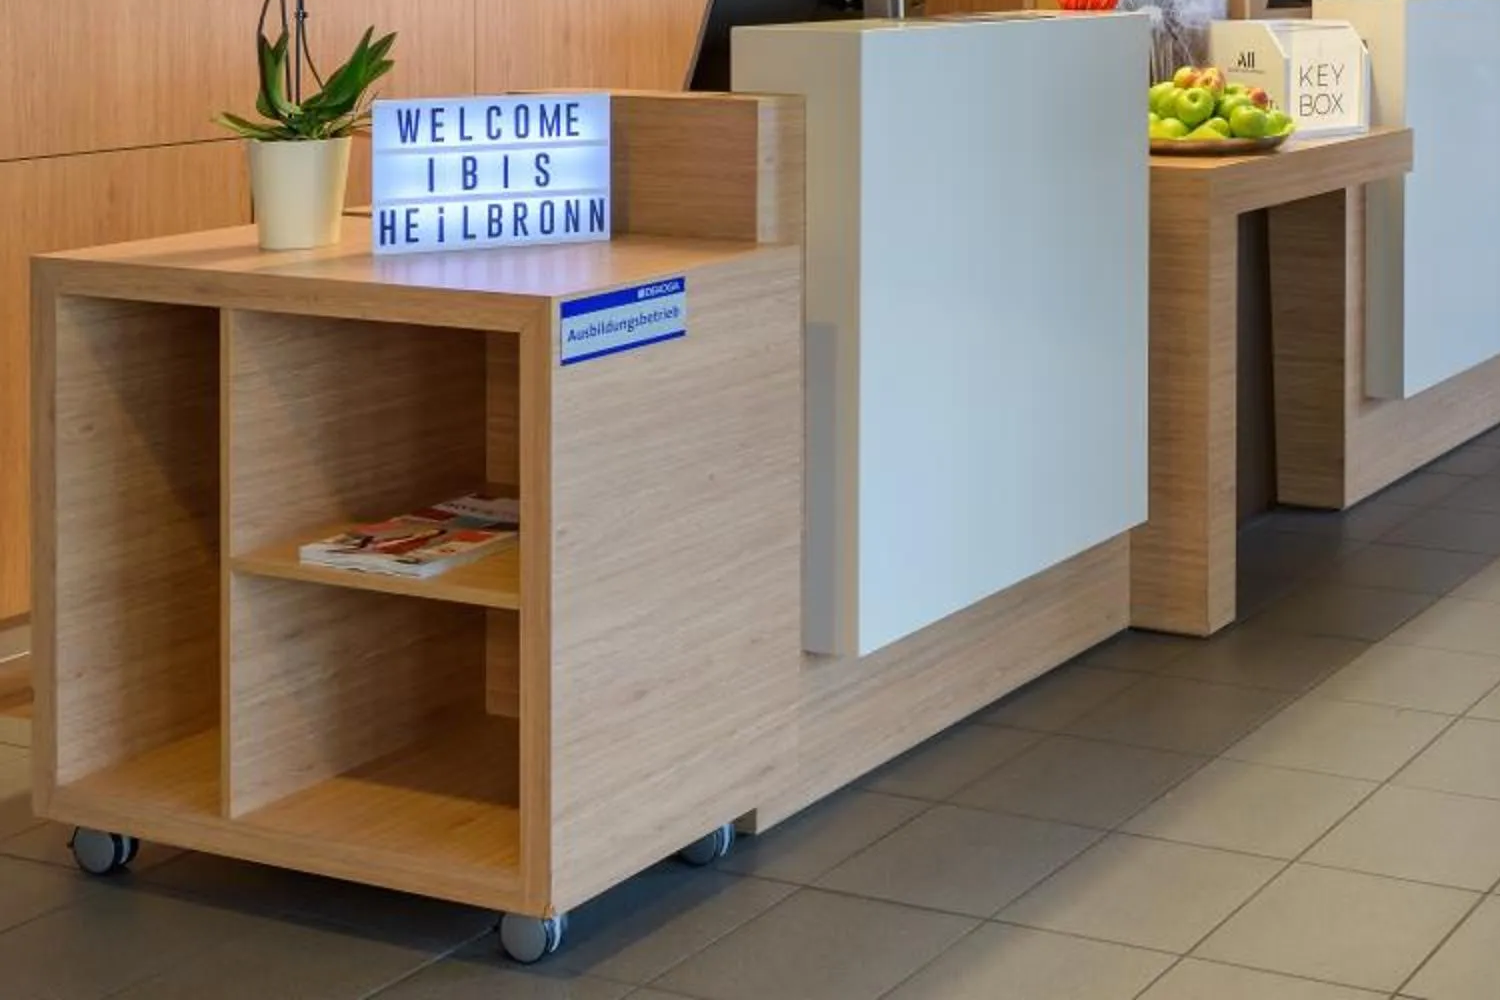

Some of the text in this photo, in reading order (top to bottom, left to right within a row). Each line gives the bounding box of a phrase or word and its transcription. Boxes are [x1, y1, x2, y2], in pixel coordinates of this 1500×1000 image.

[1299, 63, 1345, 87] KEY
[397, 103, 580, 144] WELCOME
[1299, 93, 1344, 117] BOX
[428, 152, 551, 193] IBIS
[567, 305, 680, 342] Ausbildungsbetrieb
